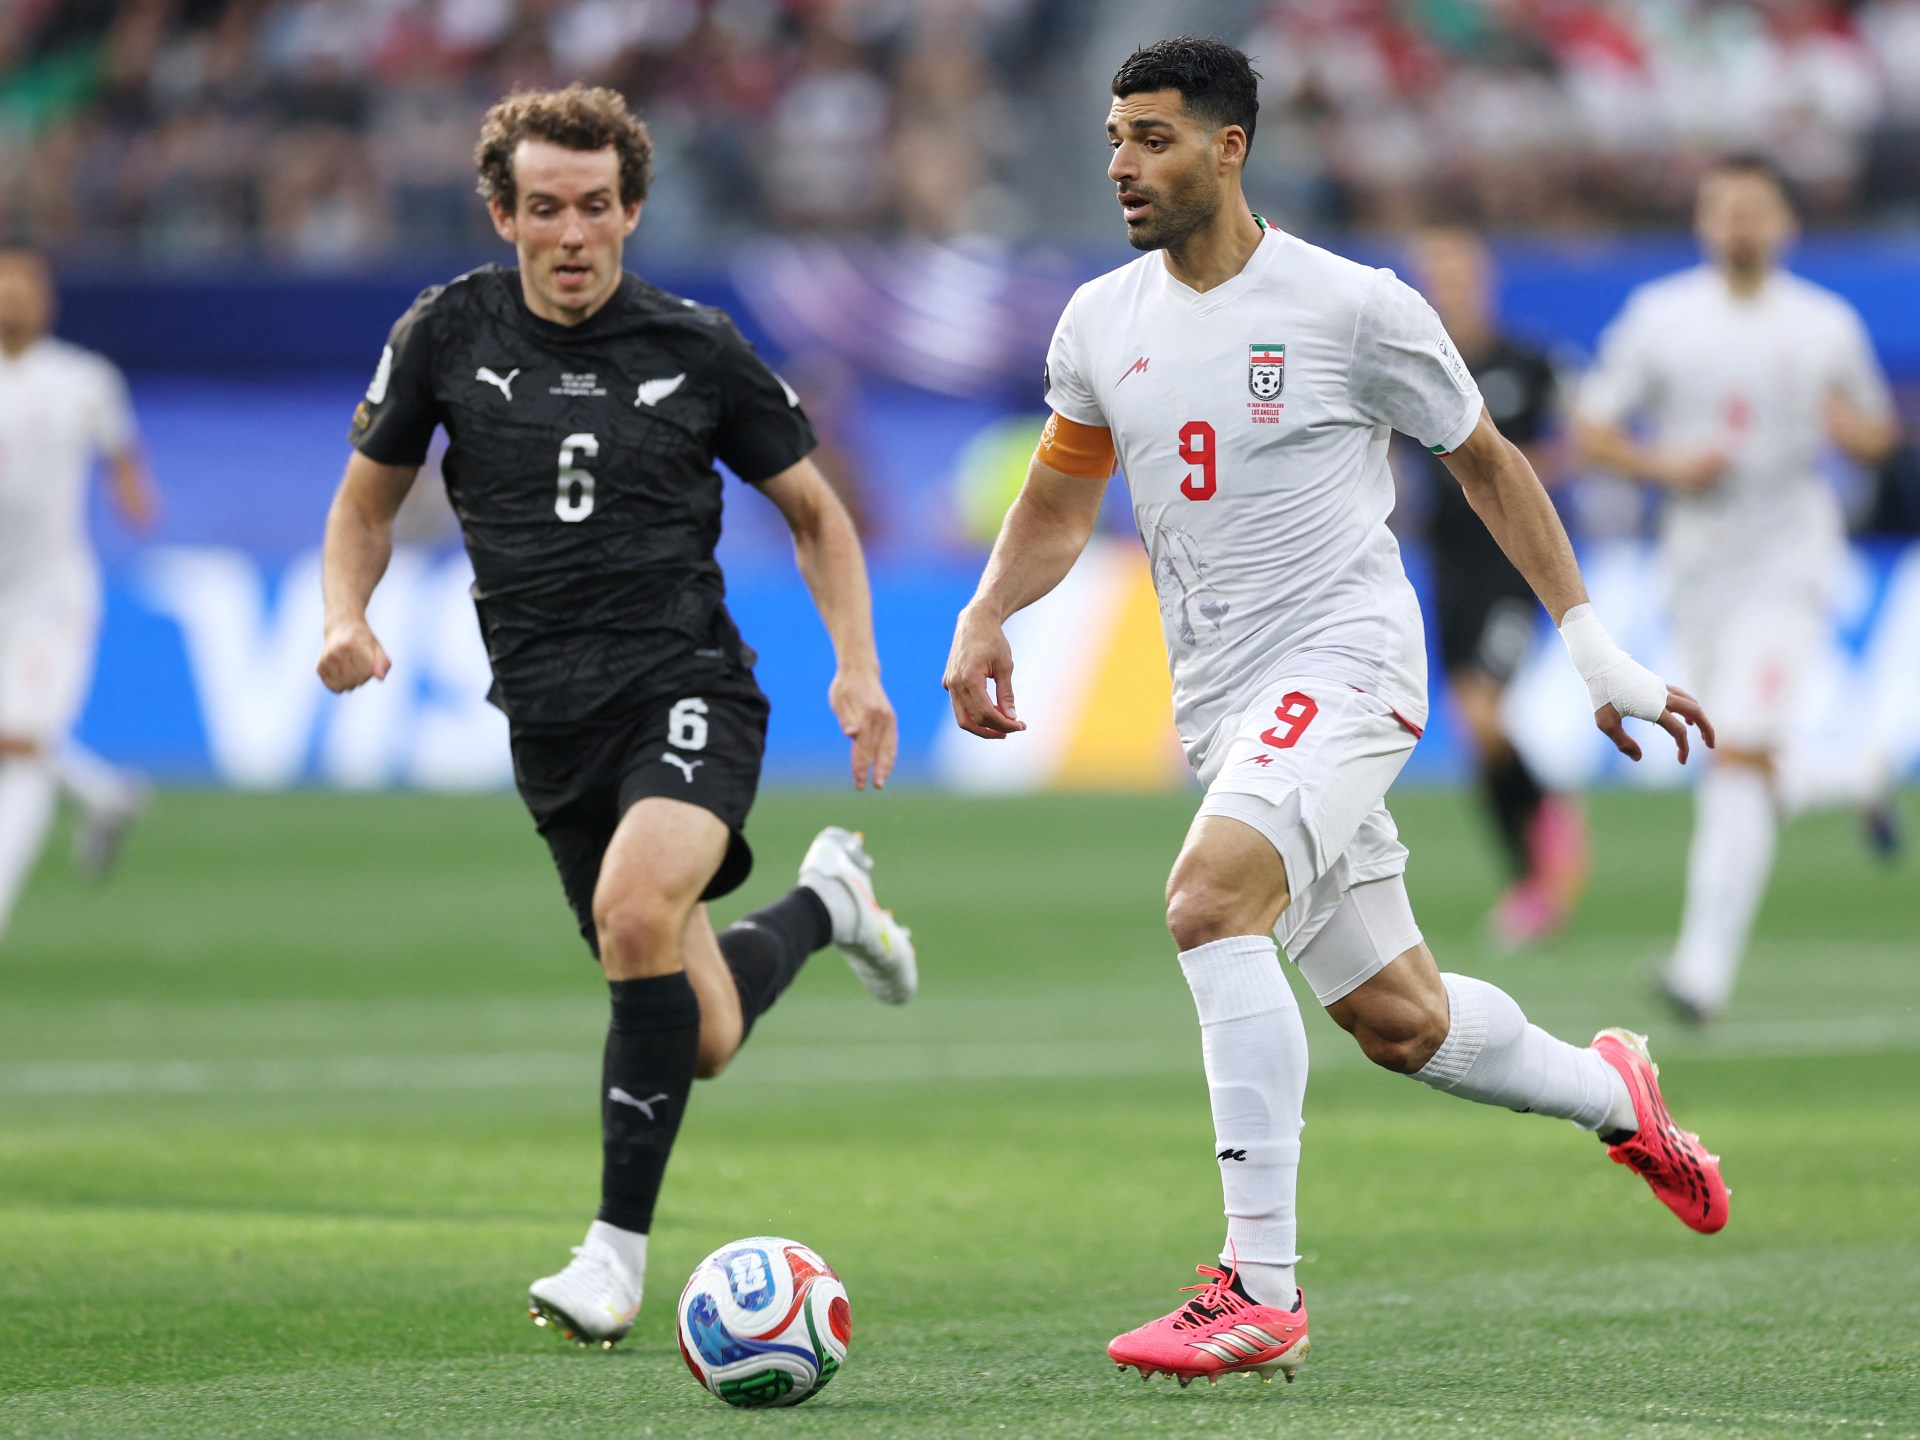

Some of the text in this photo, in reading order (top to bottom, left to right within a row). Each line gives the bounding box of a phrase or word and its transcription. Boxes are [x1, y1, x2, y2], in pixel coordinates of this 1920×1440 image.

[554, 432, 599, 523] 6
[1178, 420, 1217, 502] 9
[148, 548, 512, 788] VIS
[667, 697, 709, 751] 6
[1259, 691, 1319, 749] 9
